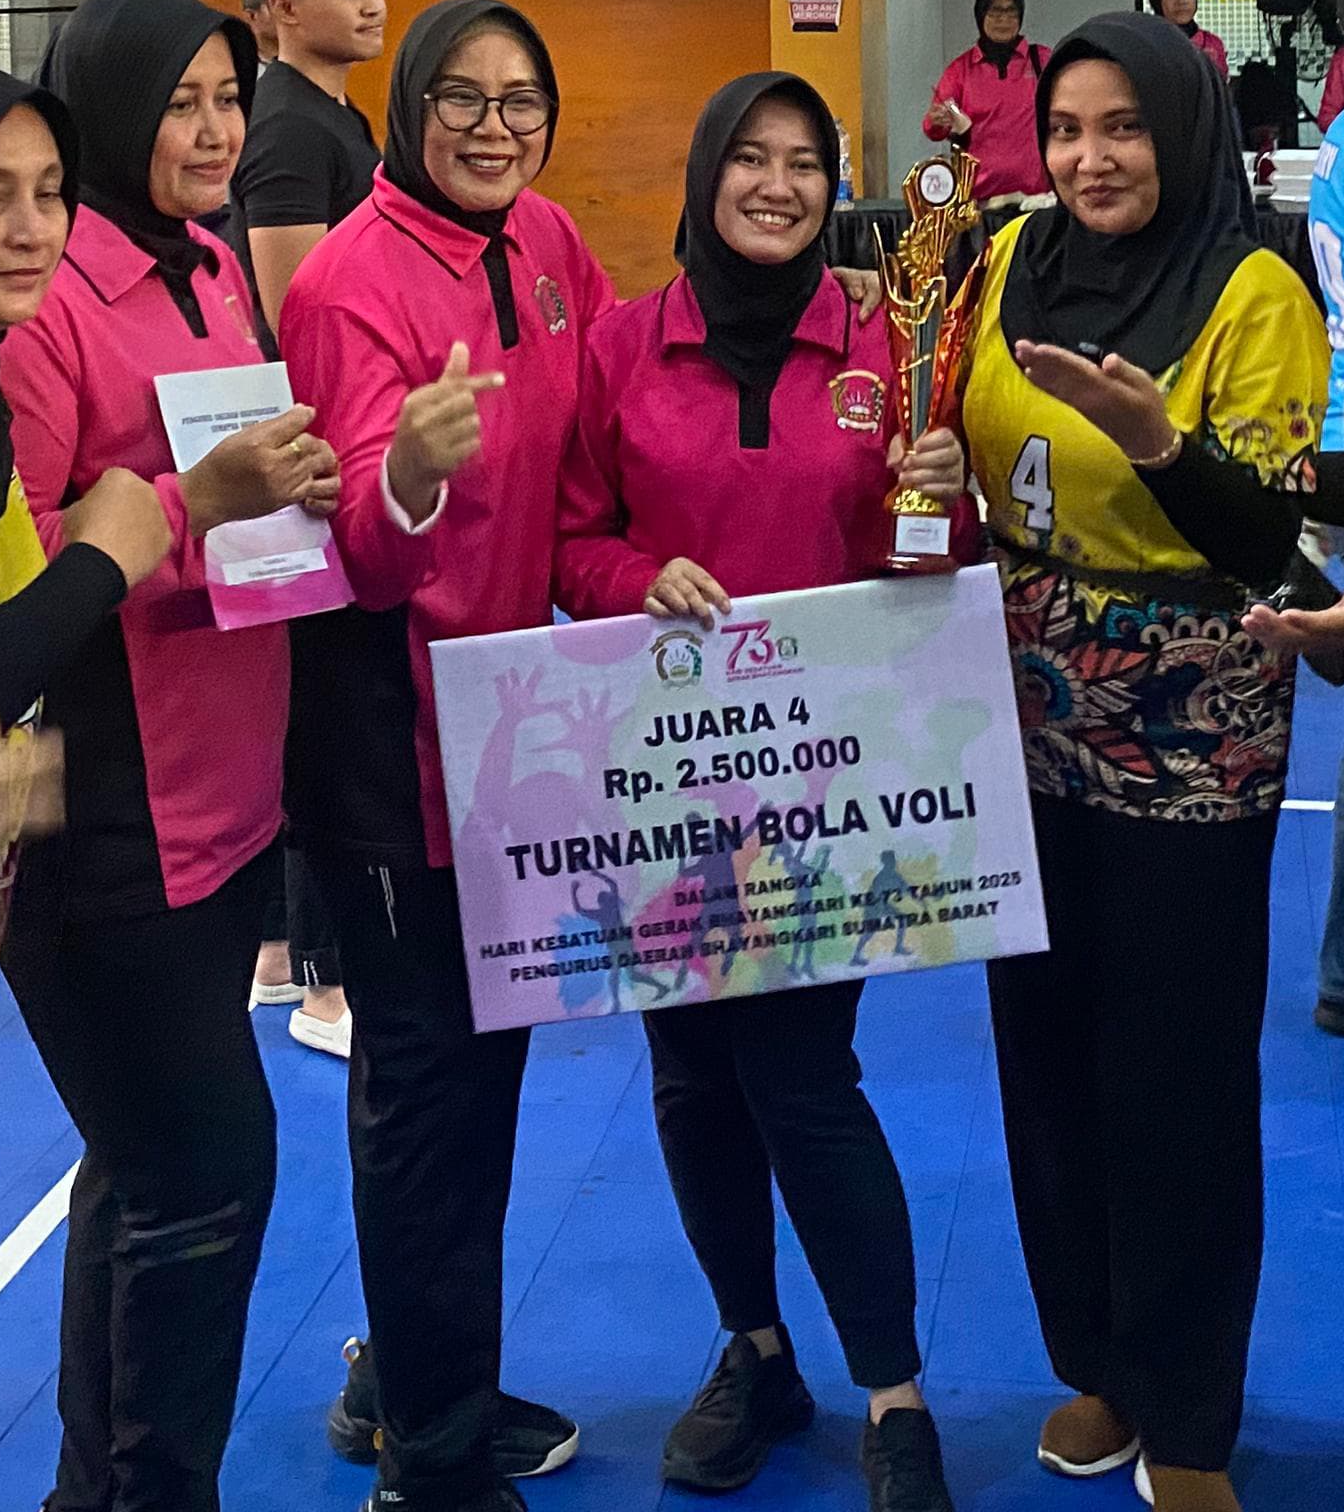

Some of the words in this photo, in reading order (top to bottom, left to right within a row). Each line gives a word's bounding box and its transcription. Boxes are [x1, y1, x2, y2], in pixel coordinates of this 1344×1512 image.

[1010, 434, 1054, 531] 4
[721, 619, 775, 671] 73
[644, 702, 776, 747] JUARA
[788, 696, 810, 726] 4
[604, 768, 664, 803] Rp.
[676, 736, 861, 789] 2.500.000
[505, 815, 744, 881] TURNAMEN
[759, 799, 869, 846] BOLA
[880, 782, 978, 829] VOLI
[480, 940, 525, 959] HARI
[532, 926, 633, 953] KESATUAN
[639, 916, 702, 938] GERAK
[908, 878, 972, 900] TAHUN
[978, 871, 1022, 889] 2025
[674, 885, 739, 907] DALAM
[745, 870, 824, 896] RANGKA
[510, 955, 612, 982] PENGURUS
[618, 945, 694, 968] DAERAH
[700, 926, 837, 958] BHAYANGKARI
[842, 912, 932, 936] SUMATRA
[938, 901, 1000, 923] BARAT
